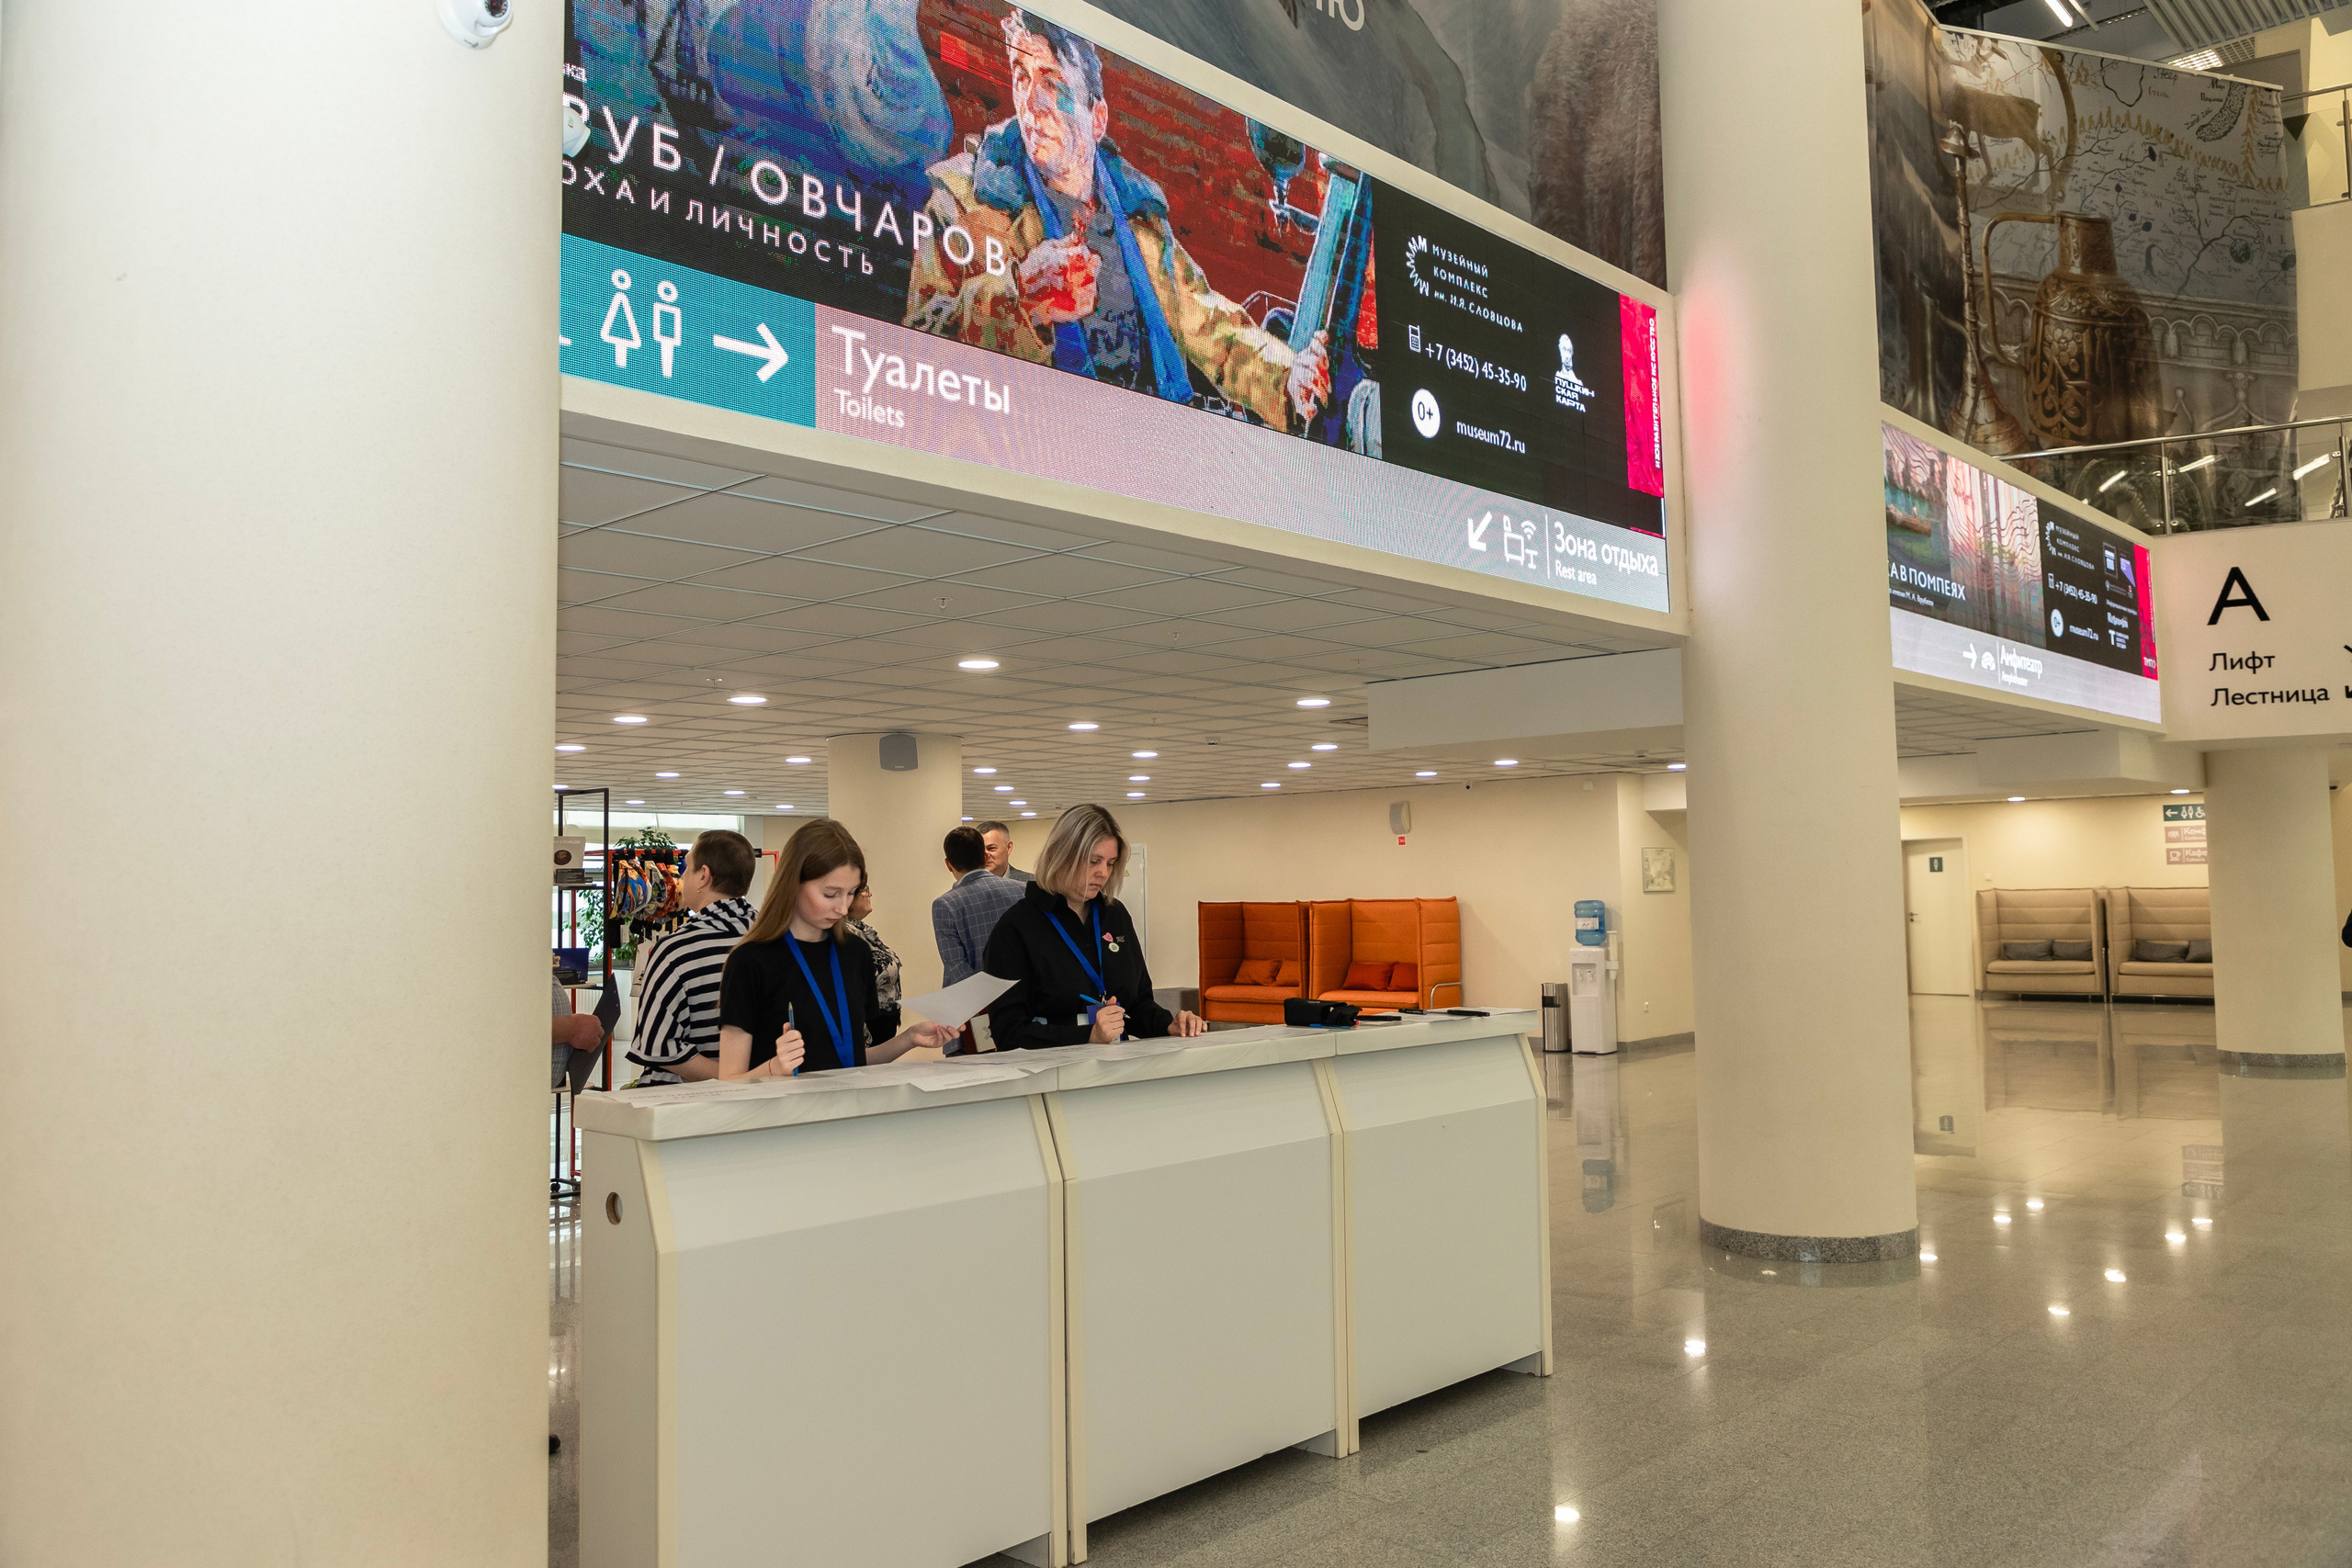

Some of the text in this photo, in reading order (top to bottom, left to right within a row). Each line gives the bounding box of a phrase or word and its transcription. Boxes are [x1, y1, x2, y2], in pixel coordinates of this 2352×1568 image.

[650, 187, 670, 215] И
[685, 199, 873, 275] ЛИЧНОСТЬ
[751, 160, 1006, 276] ОВЧАРОВ
[1432, 243, 1488, 277] МУЗЕЙНЫЙ
[1433, 265, 1488, 299] КОМПЛЕКС
[1434, 290, 1448, 303] им.
[1469, 301, 1523, 333] СЛОВЦОВА
[831, 325, 1011, 414] Туалеты
[1425, 343, 1527, 391] +7 (3452) 45-35-90
[833, 389, 905, 428] Toilets
[1555, 386, 1578, 401] СКАЯ
[1555, 394, 1586, 412] КАРТА
[1418, 401, 1433, 422] 0+
[1456, 421, 1526, 454] museum72.ru
[1554, 522, 1659, 577] Зона отдыха
[1555, 560, 1597, 585] Rest area
[1888, 559, 1899, 580] А
[1908, 567, 1966, 601] ПОМПЕЯХ
[2209, 650, 2276, 674] Лифт
[2211, 687, 2330, 706] Лестница
